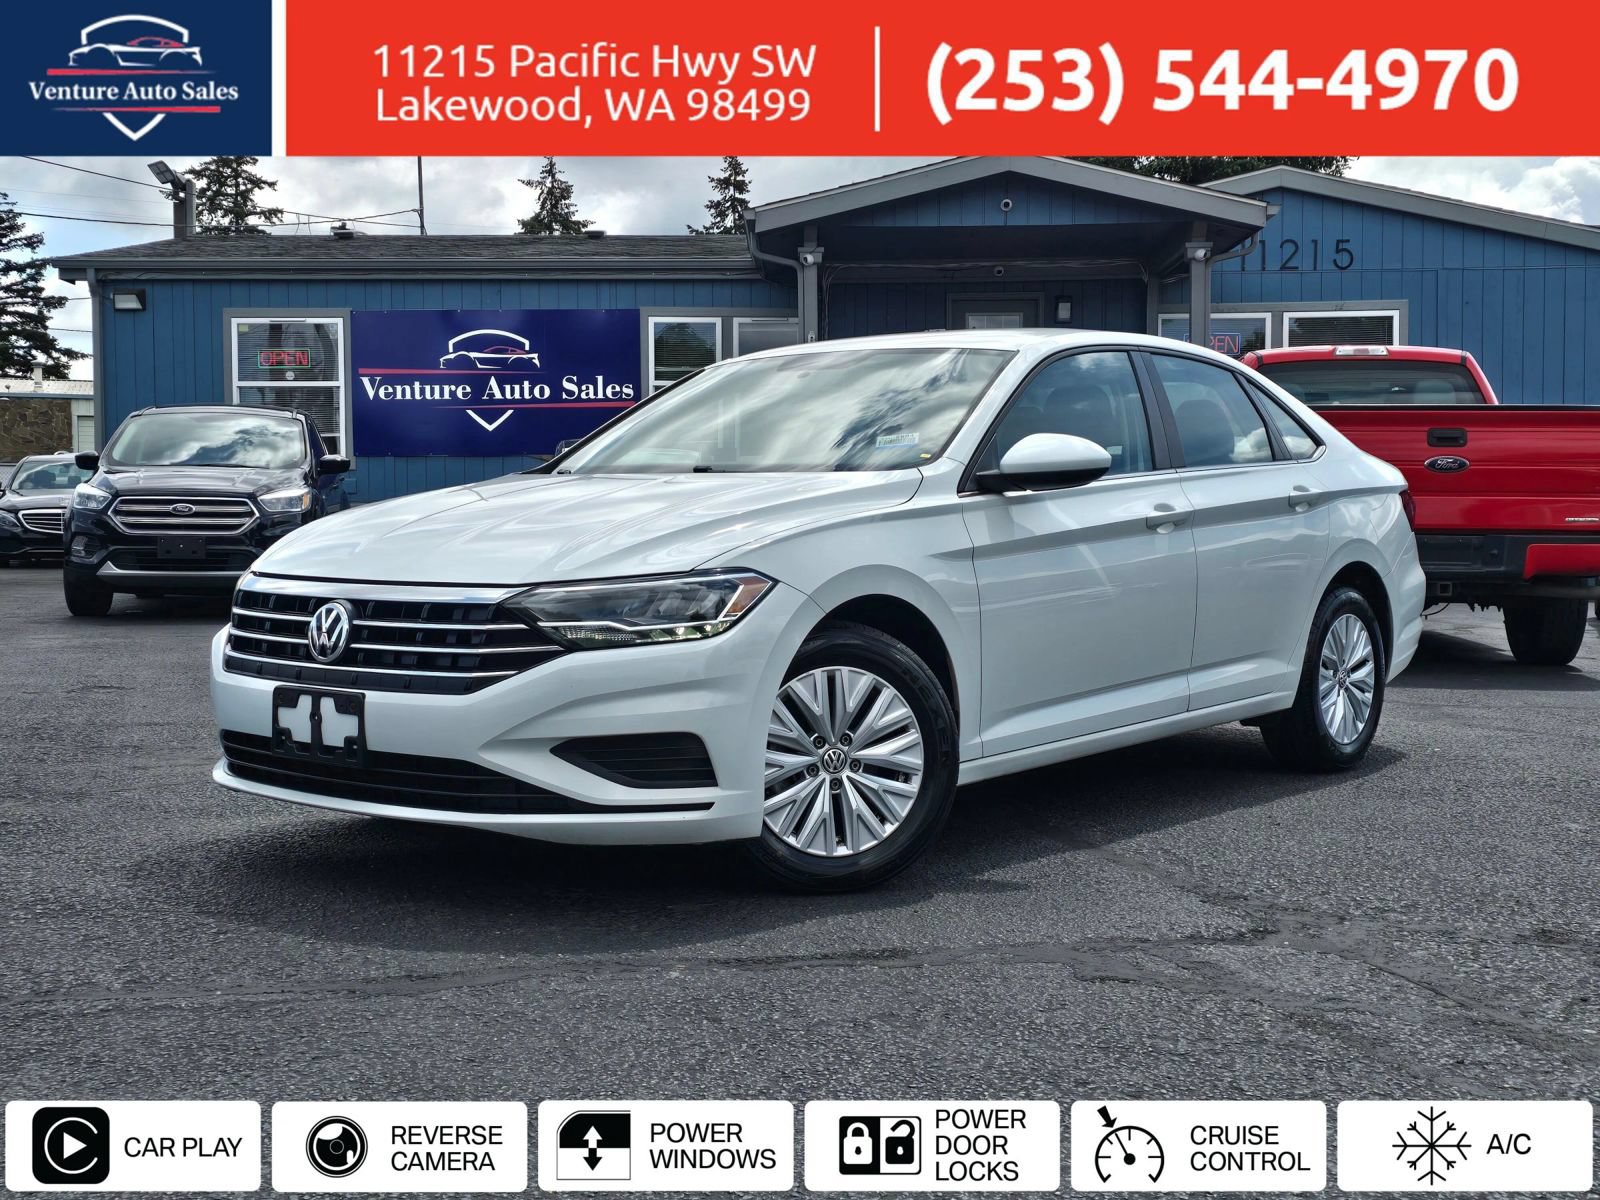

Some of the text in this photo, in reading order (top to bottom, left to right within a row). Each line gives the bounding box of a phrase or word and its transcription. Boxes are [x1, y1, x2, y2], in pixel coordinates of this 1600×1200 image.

[260, 350, 309, 366] OPEN
[359, 374, 635, 401] Venture Auto Sales
